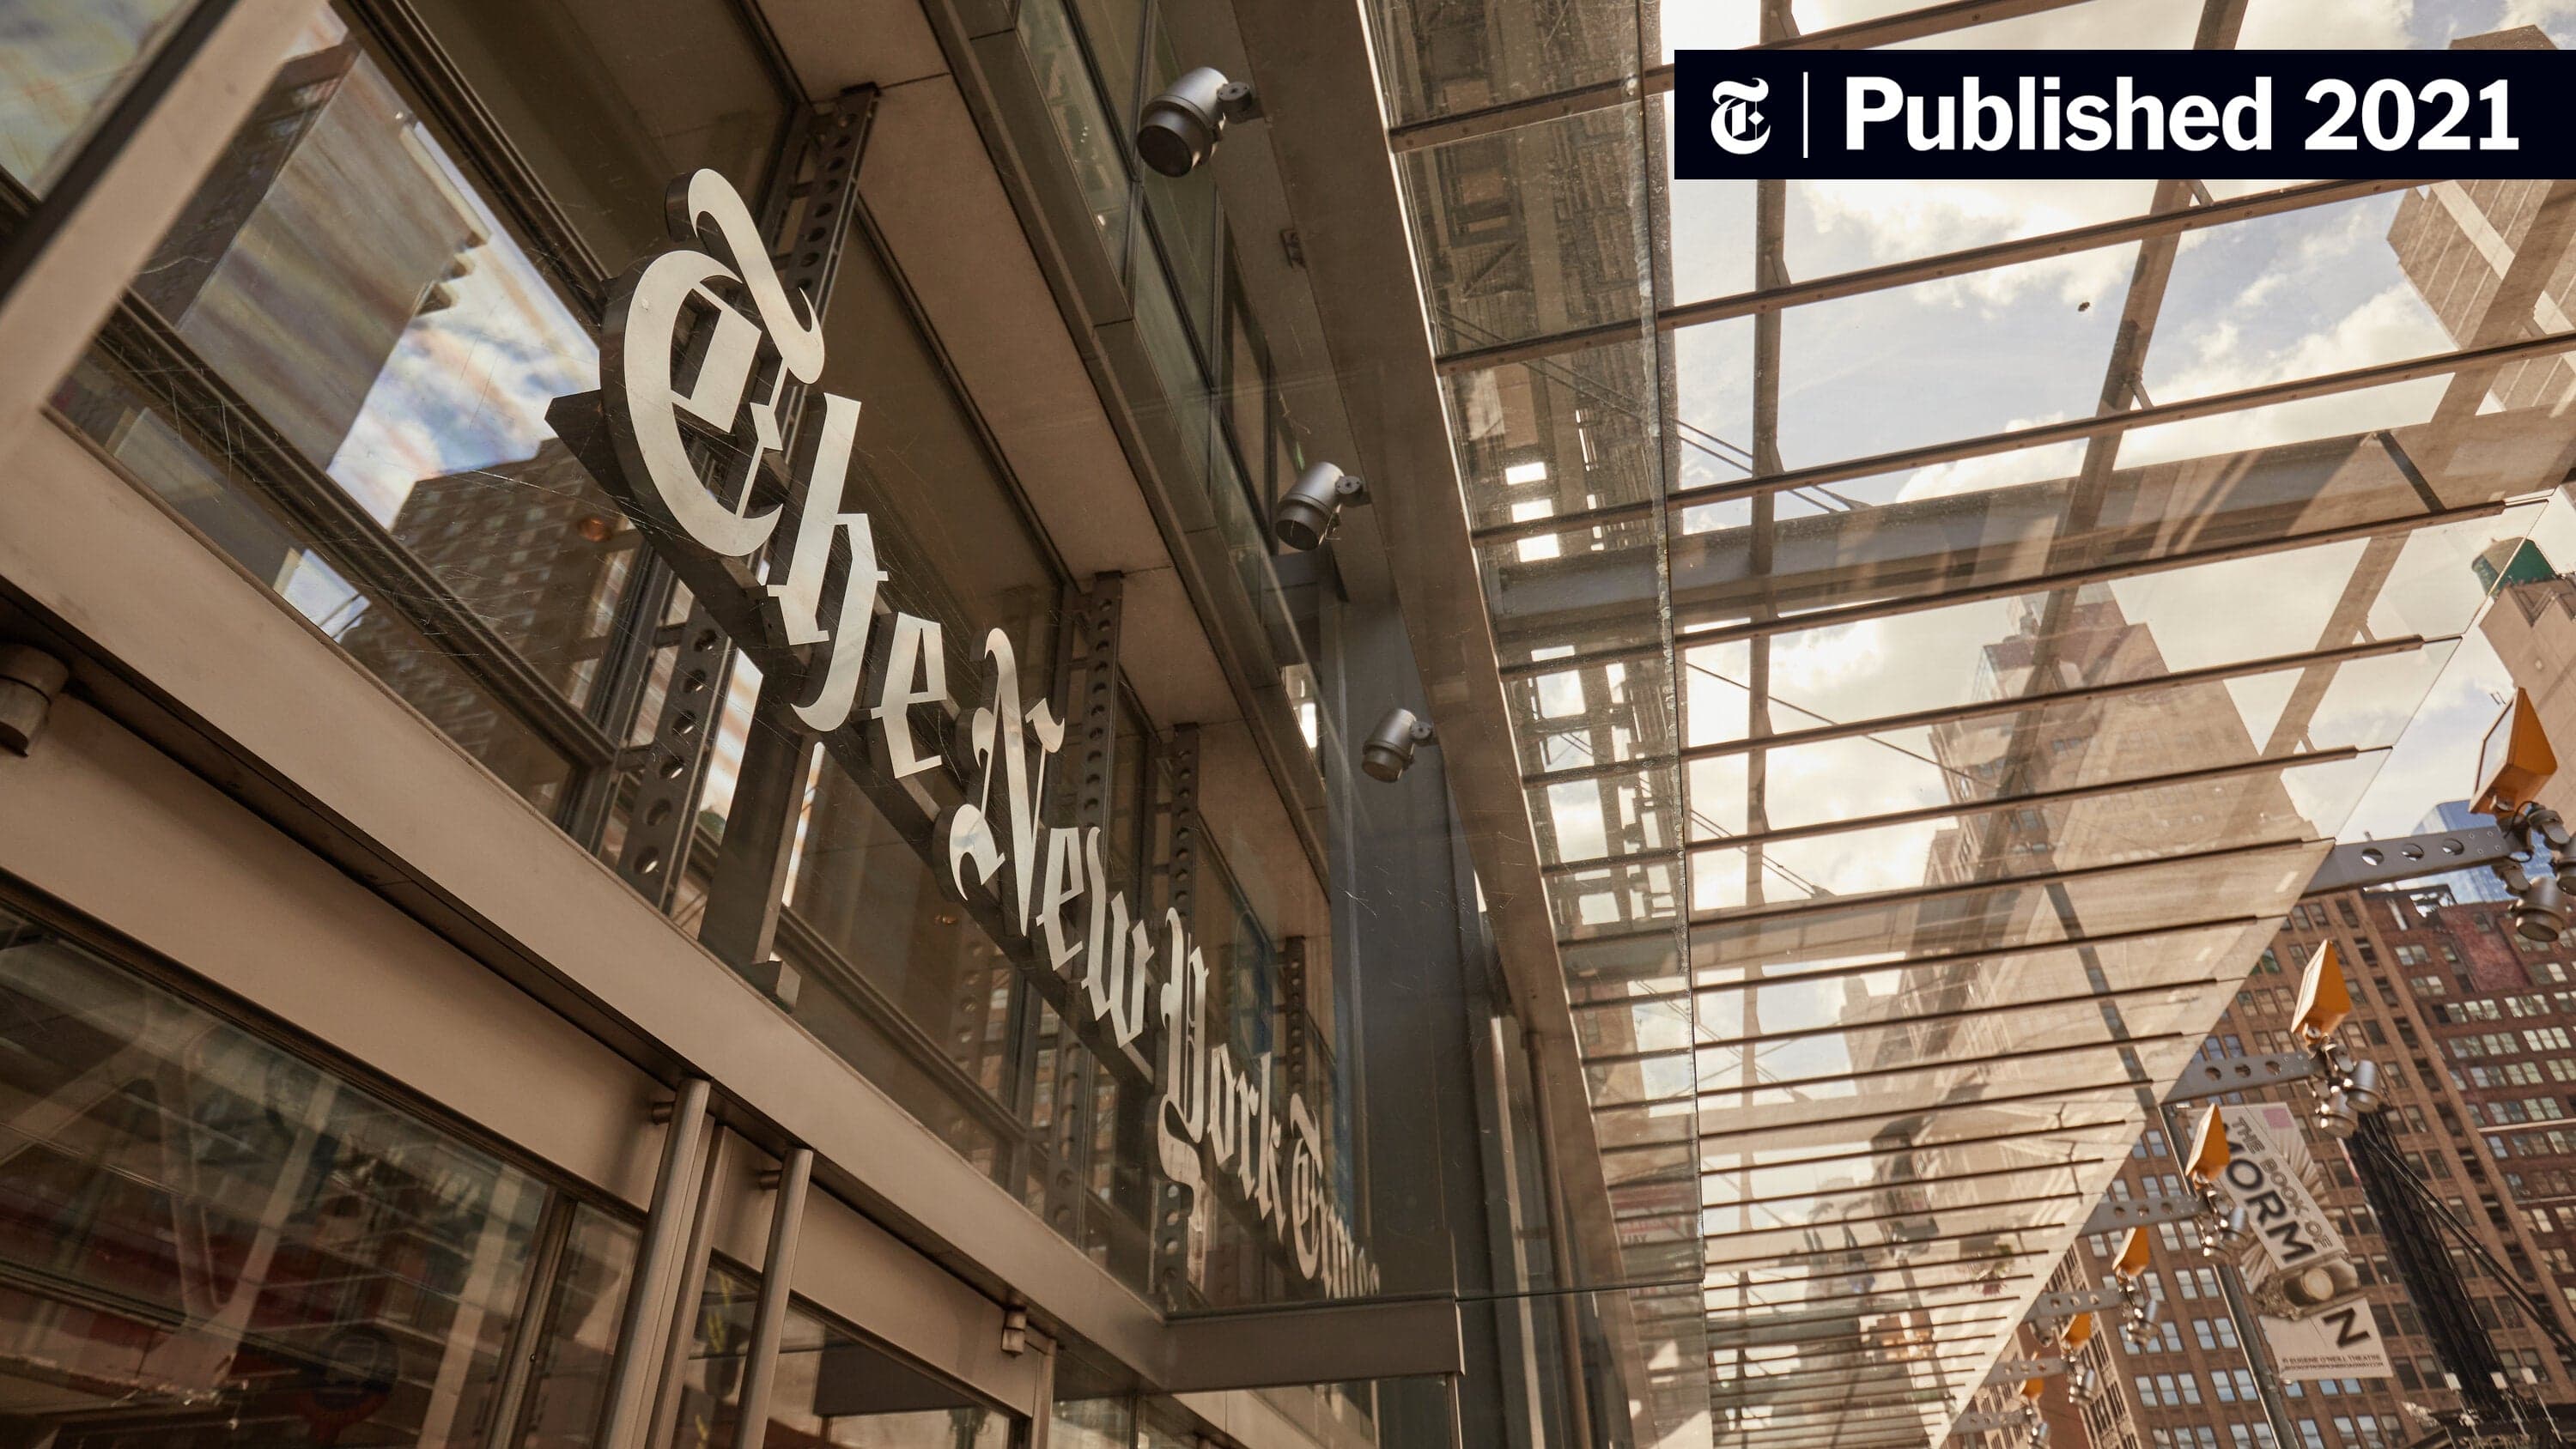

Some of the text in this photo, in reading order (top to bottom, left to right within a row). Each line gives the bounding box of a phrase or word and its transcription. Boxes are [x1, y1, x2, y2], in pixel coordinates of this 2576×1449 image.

[624, 168, 947, 779] The
[950, 627, 1154, 1048] New
[1158, 907, 1286, 1243] York
[2232, 1116, 2334, 1249] THE BOOK OF
